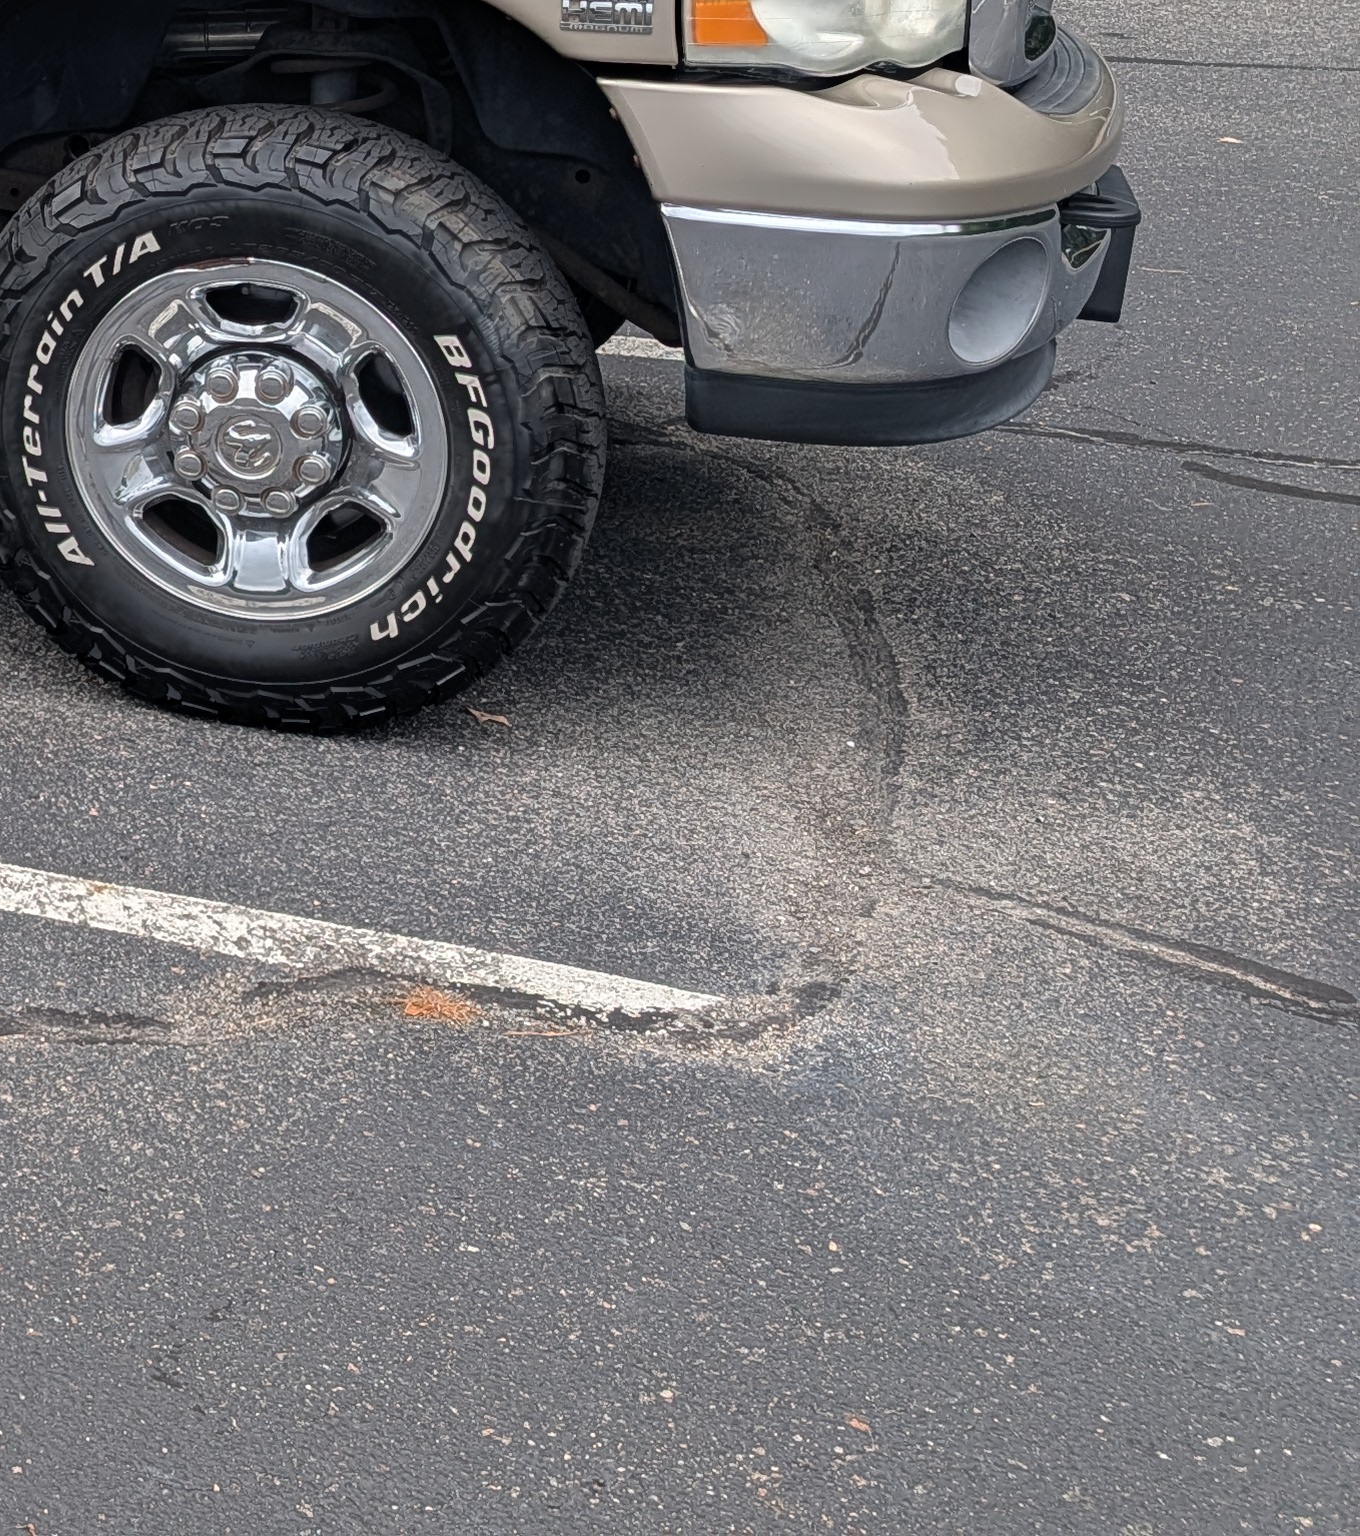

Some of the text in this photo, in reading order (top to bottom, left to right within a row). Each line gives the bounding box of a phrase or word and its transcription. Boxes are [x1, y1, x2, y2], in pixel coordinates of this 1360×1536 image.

[562, 0, 653, 25] HEMI
[21, 289, 95, 569] All-Terrain
[82, 230, 162, 288] T/A
[368, 334, 496, 643] BFGoodrich
